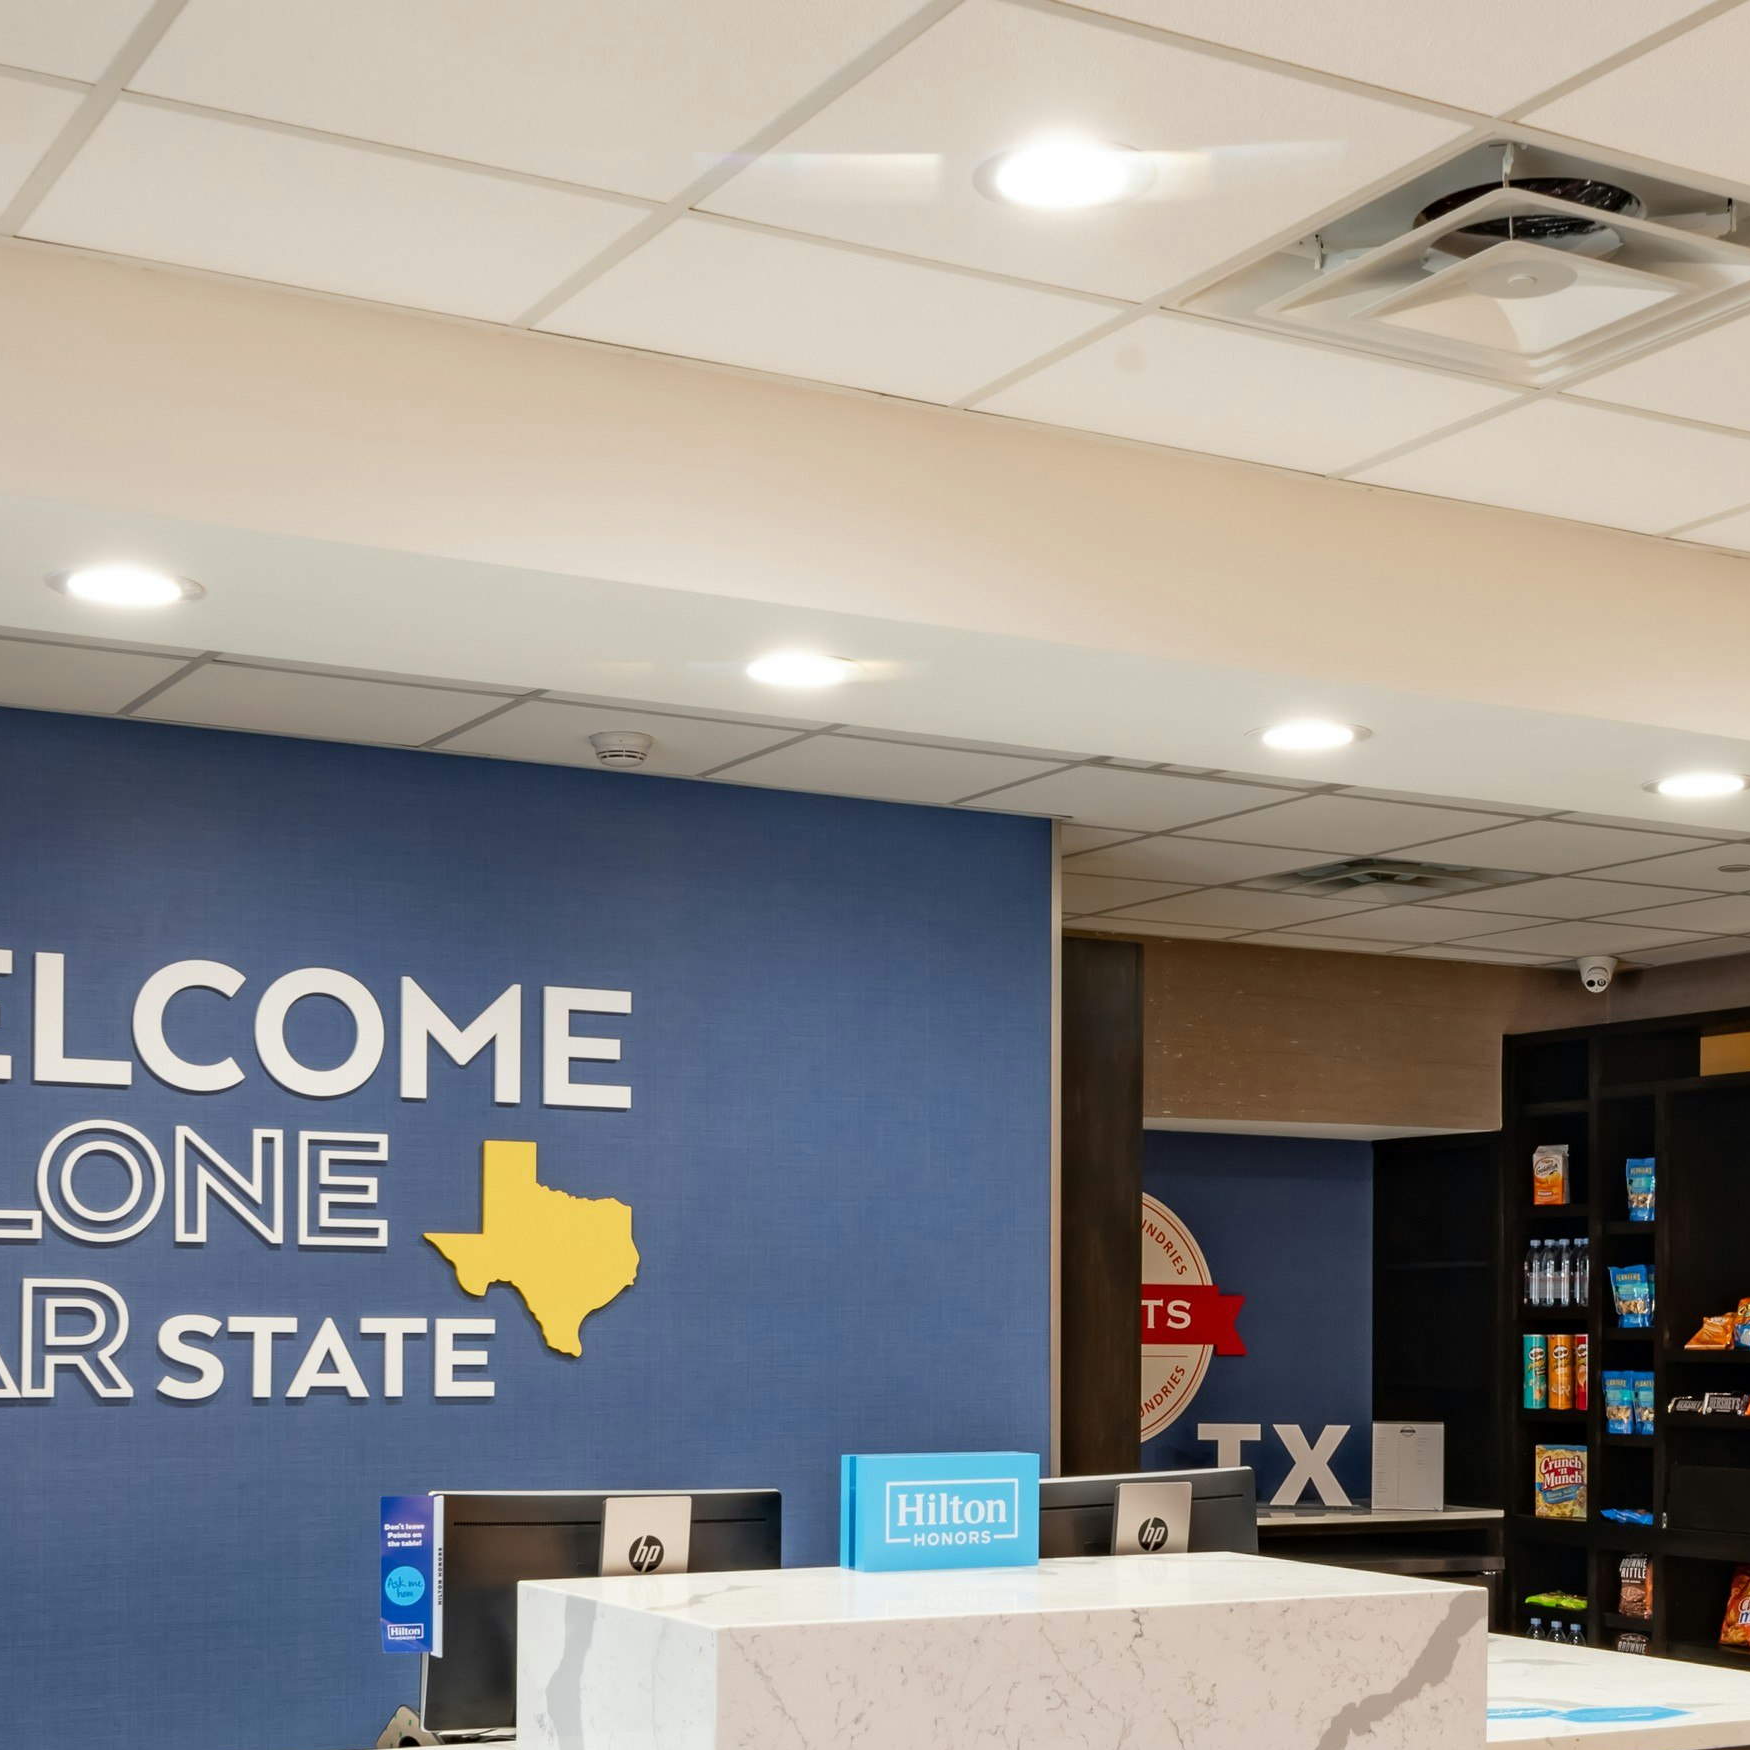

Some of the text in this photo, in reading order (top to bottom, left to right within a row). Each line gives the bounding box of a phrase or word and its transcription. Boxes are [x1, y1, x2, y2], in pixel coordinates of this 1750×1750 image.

[1142, 1219, 1188, 1276] NDRIES
[156, 1314, 496, 1400] STATE
[1140, 1364, 1186, 1418] NDRIES
[1197, 1423, 1353, 1507] TX
[1541, 1456, 1582, 1473] Crunch
[1544, 1471, 1582, 1489] Munch
[897, 1493, 1007, 1527] Hilton
[913, 1530, 991, 1547] HONORS
[1619, 1567, 1647, 1579] RITTLE
[387, 1576, 423, 1589] Ask me
[390, 1627, 421, 1636] Hilton
